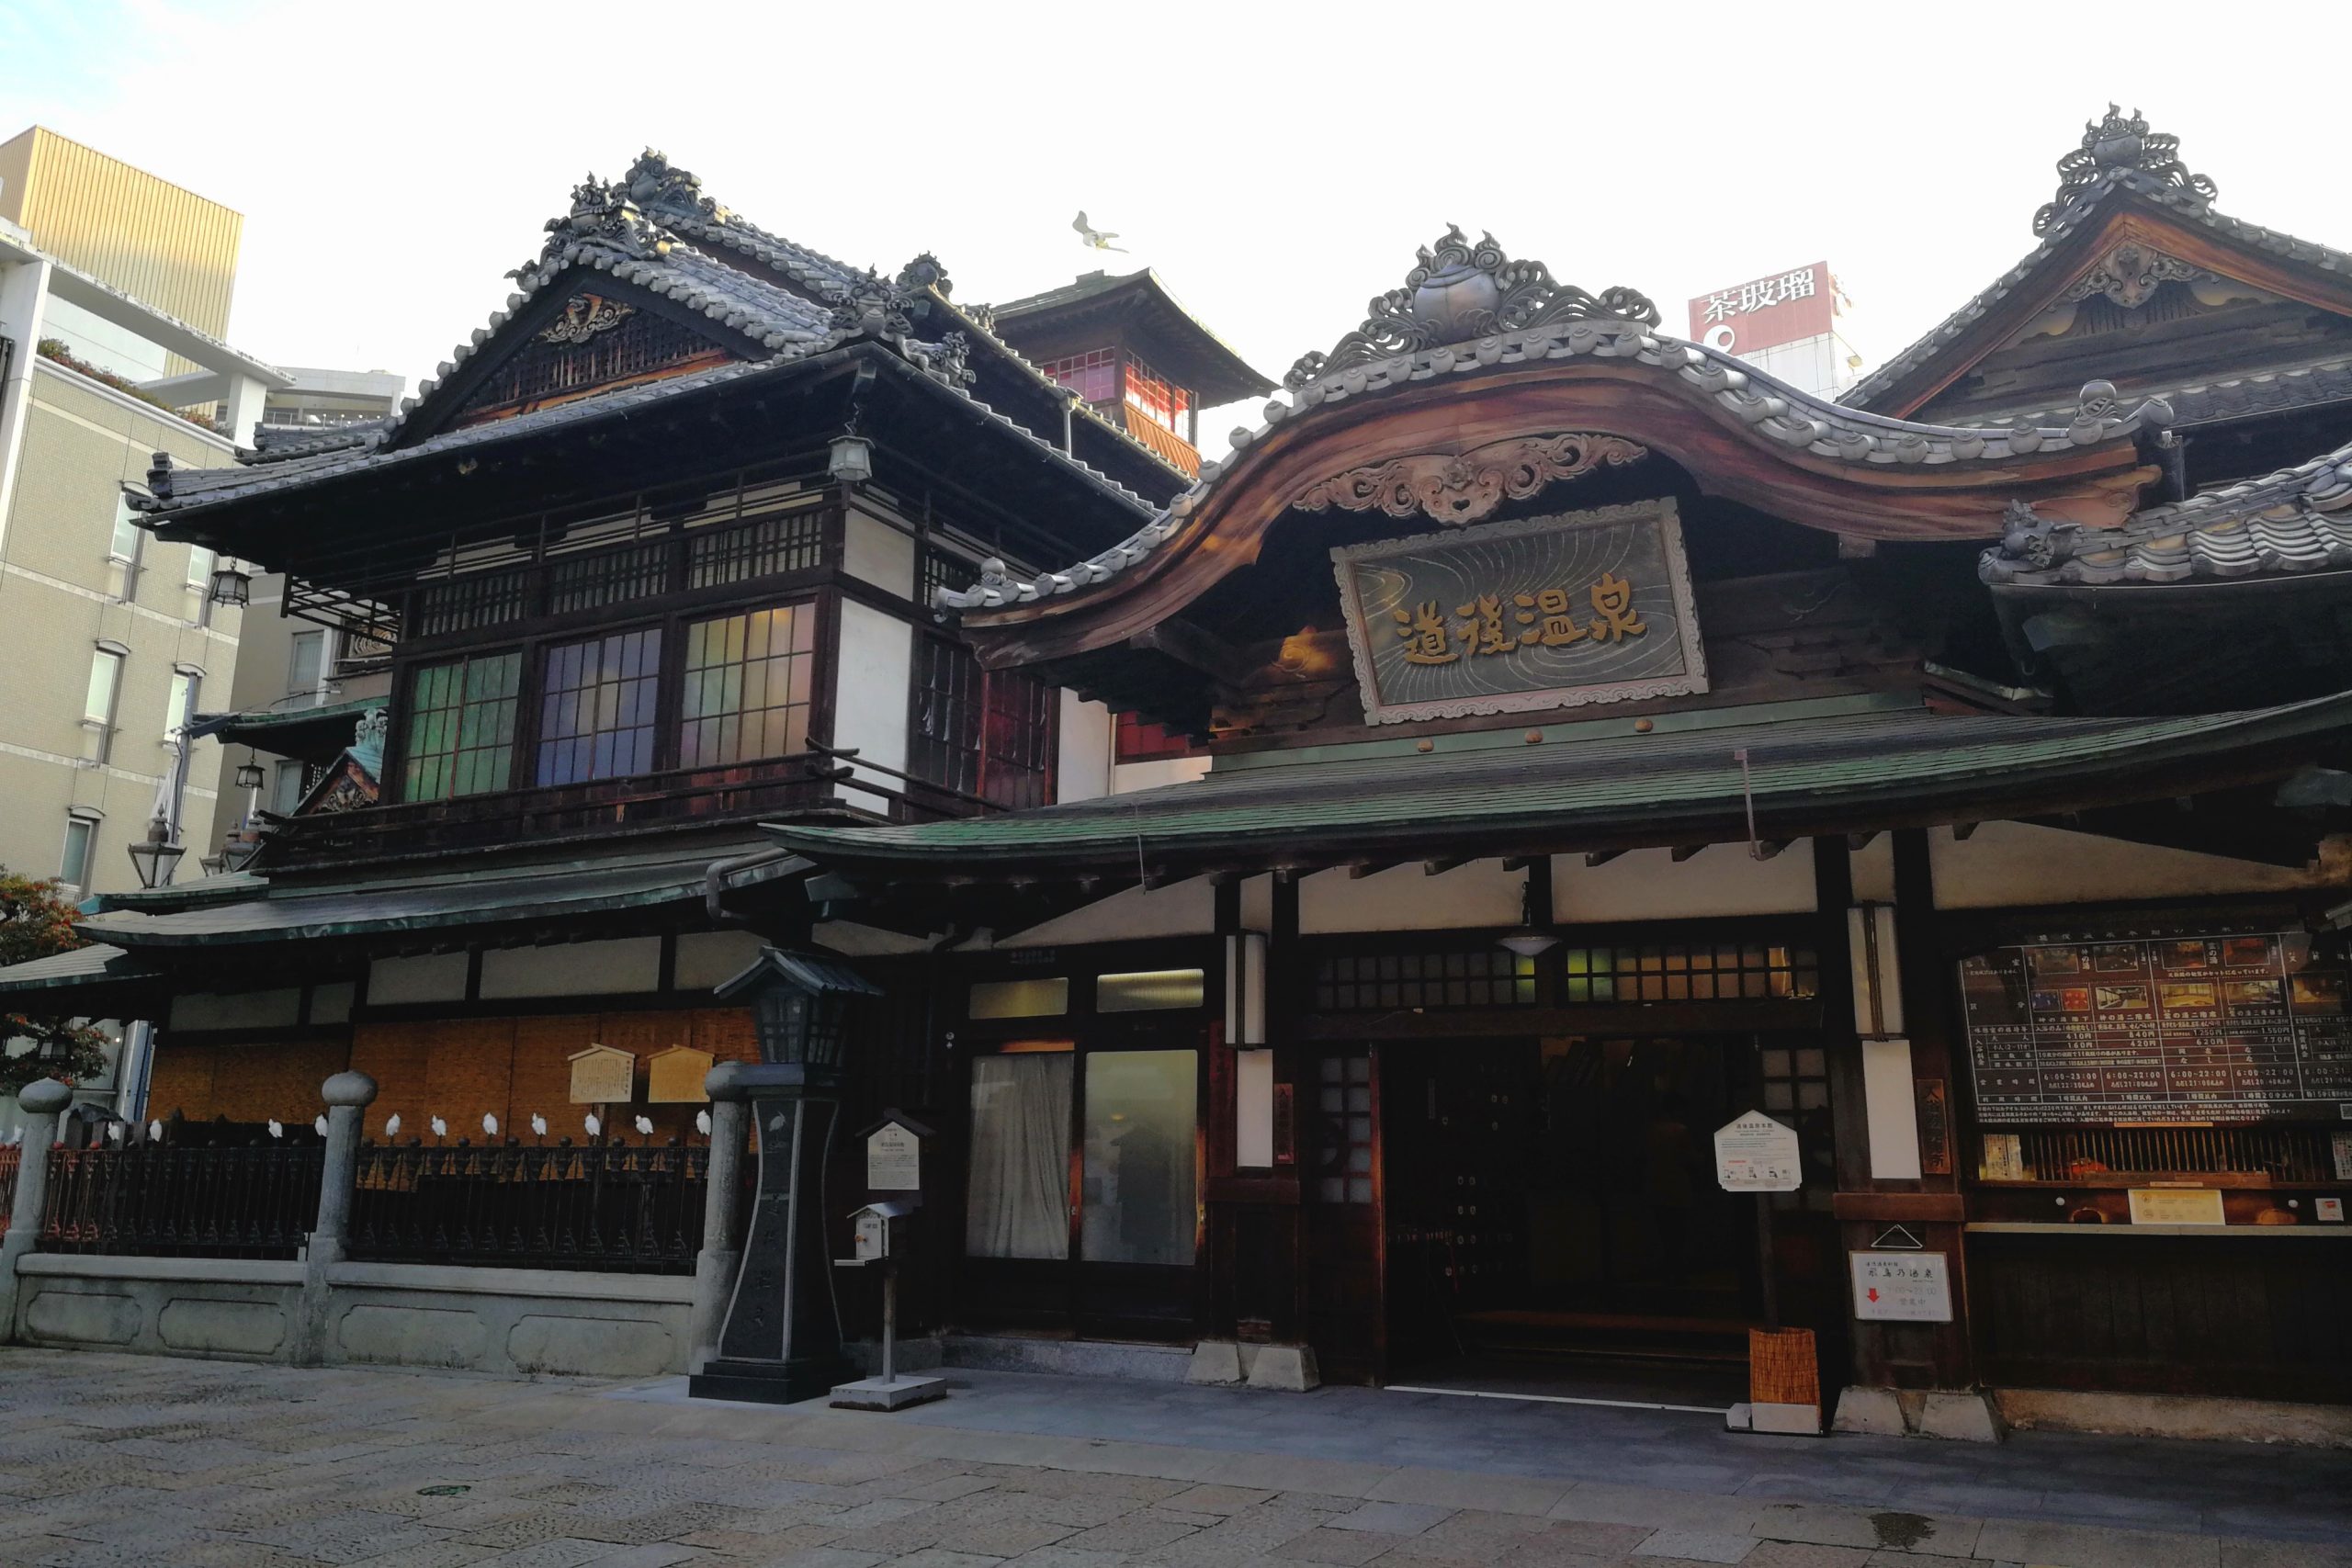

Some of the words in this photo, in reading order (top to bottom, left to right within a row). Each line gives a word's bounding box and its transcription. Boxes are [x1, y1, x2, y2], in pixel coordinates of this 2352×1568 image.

[1701, 268, 1815, 324] 茶玻瑠
[1394, 571, 1645, 665] 道後温泉
